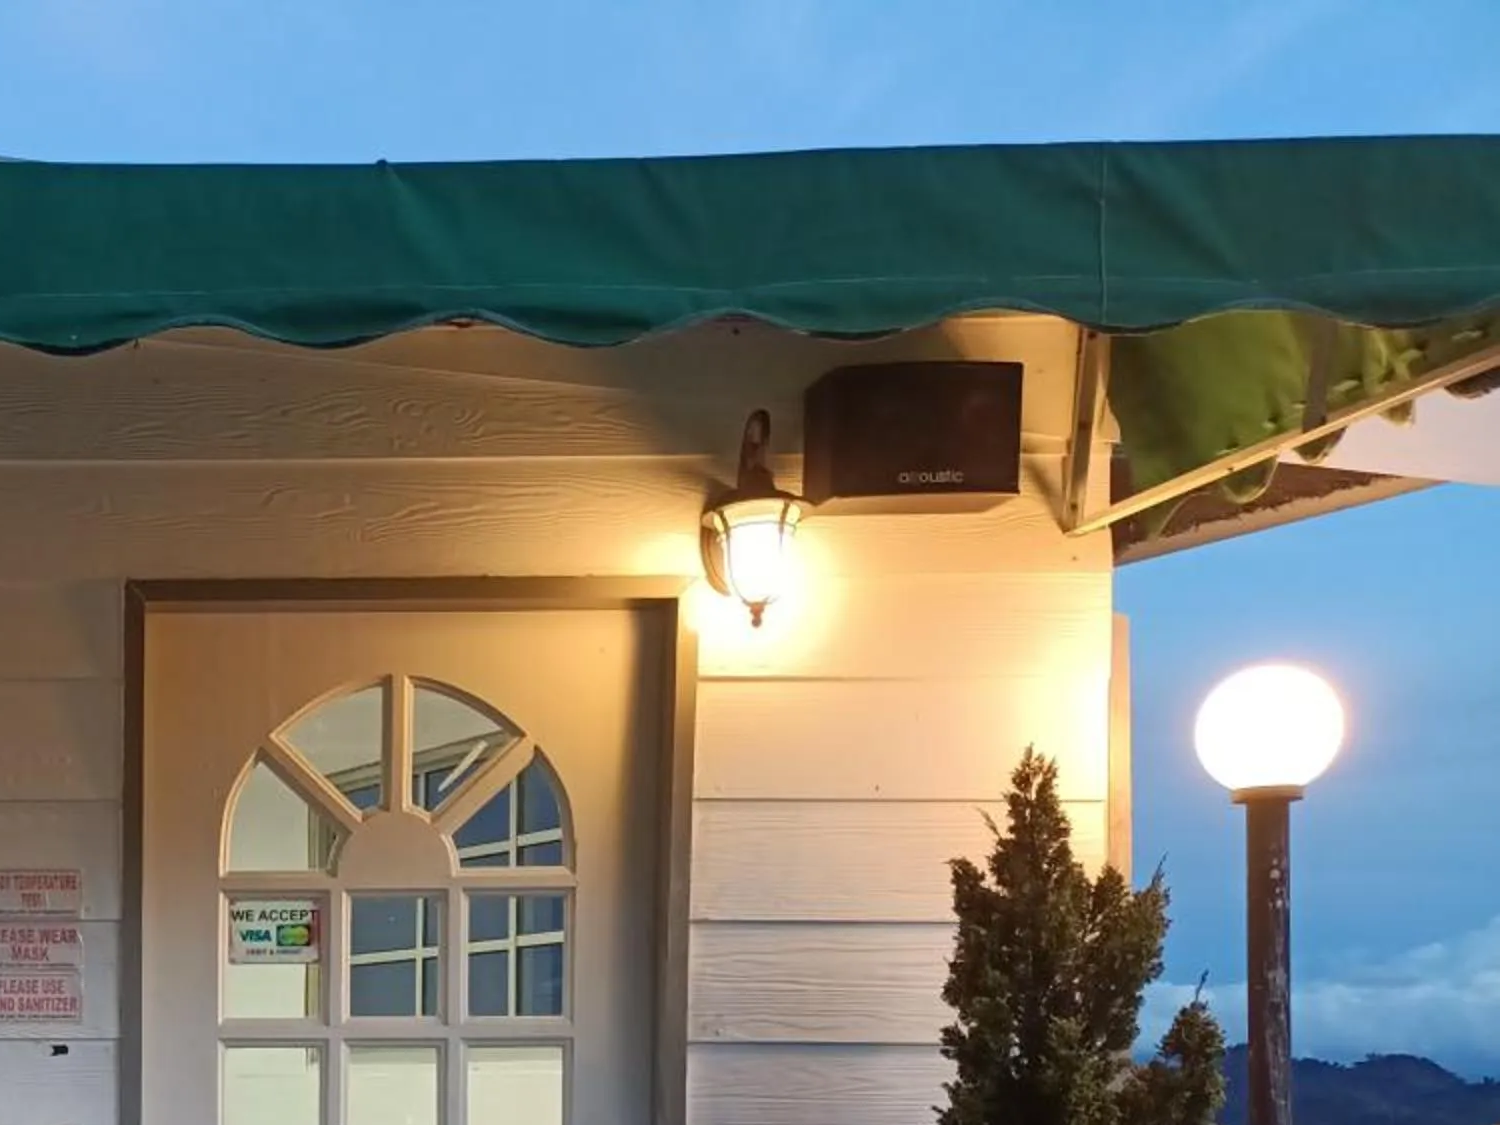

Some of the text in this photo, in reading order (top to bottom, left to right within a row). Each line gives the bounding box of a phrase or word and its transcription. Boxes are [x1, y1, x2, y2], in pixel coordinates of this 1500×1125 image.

[231, 908, 317, 922] WE ACCEPT
[39, 928, 78, 944] WEAR
[240, 929, 272, 942] VISA
[10, 945, 50, 962] MASK
[42, 979, 66, 995] USE
[18, 996, 78, 1012] SANITIZER
